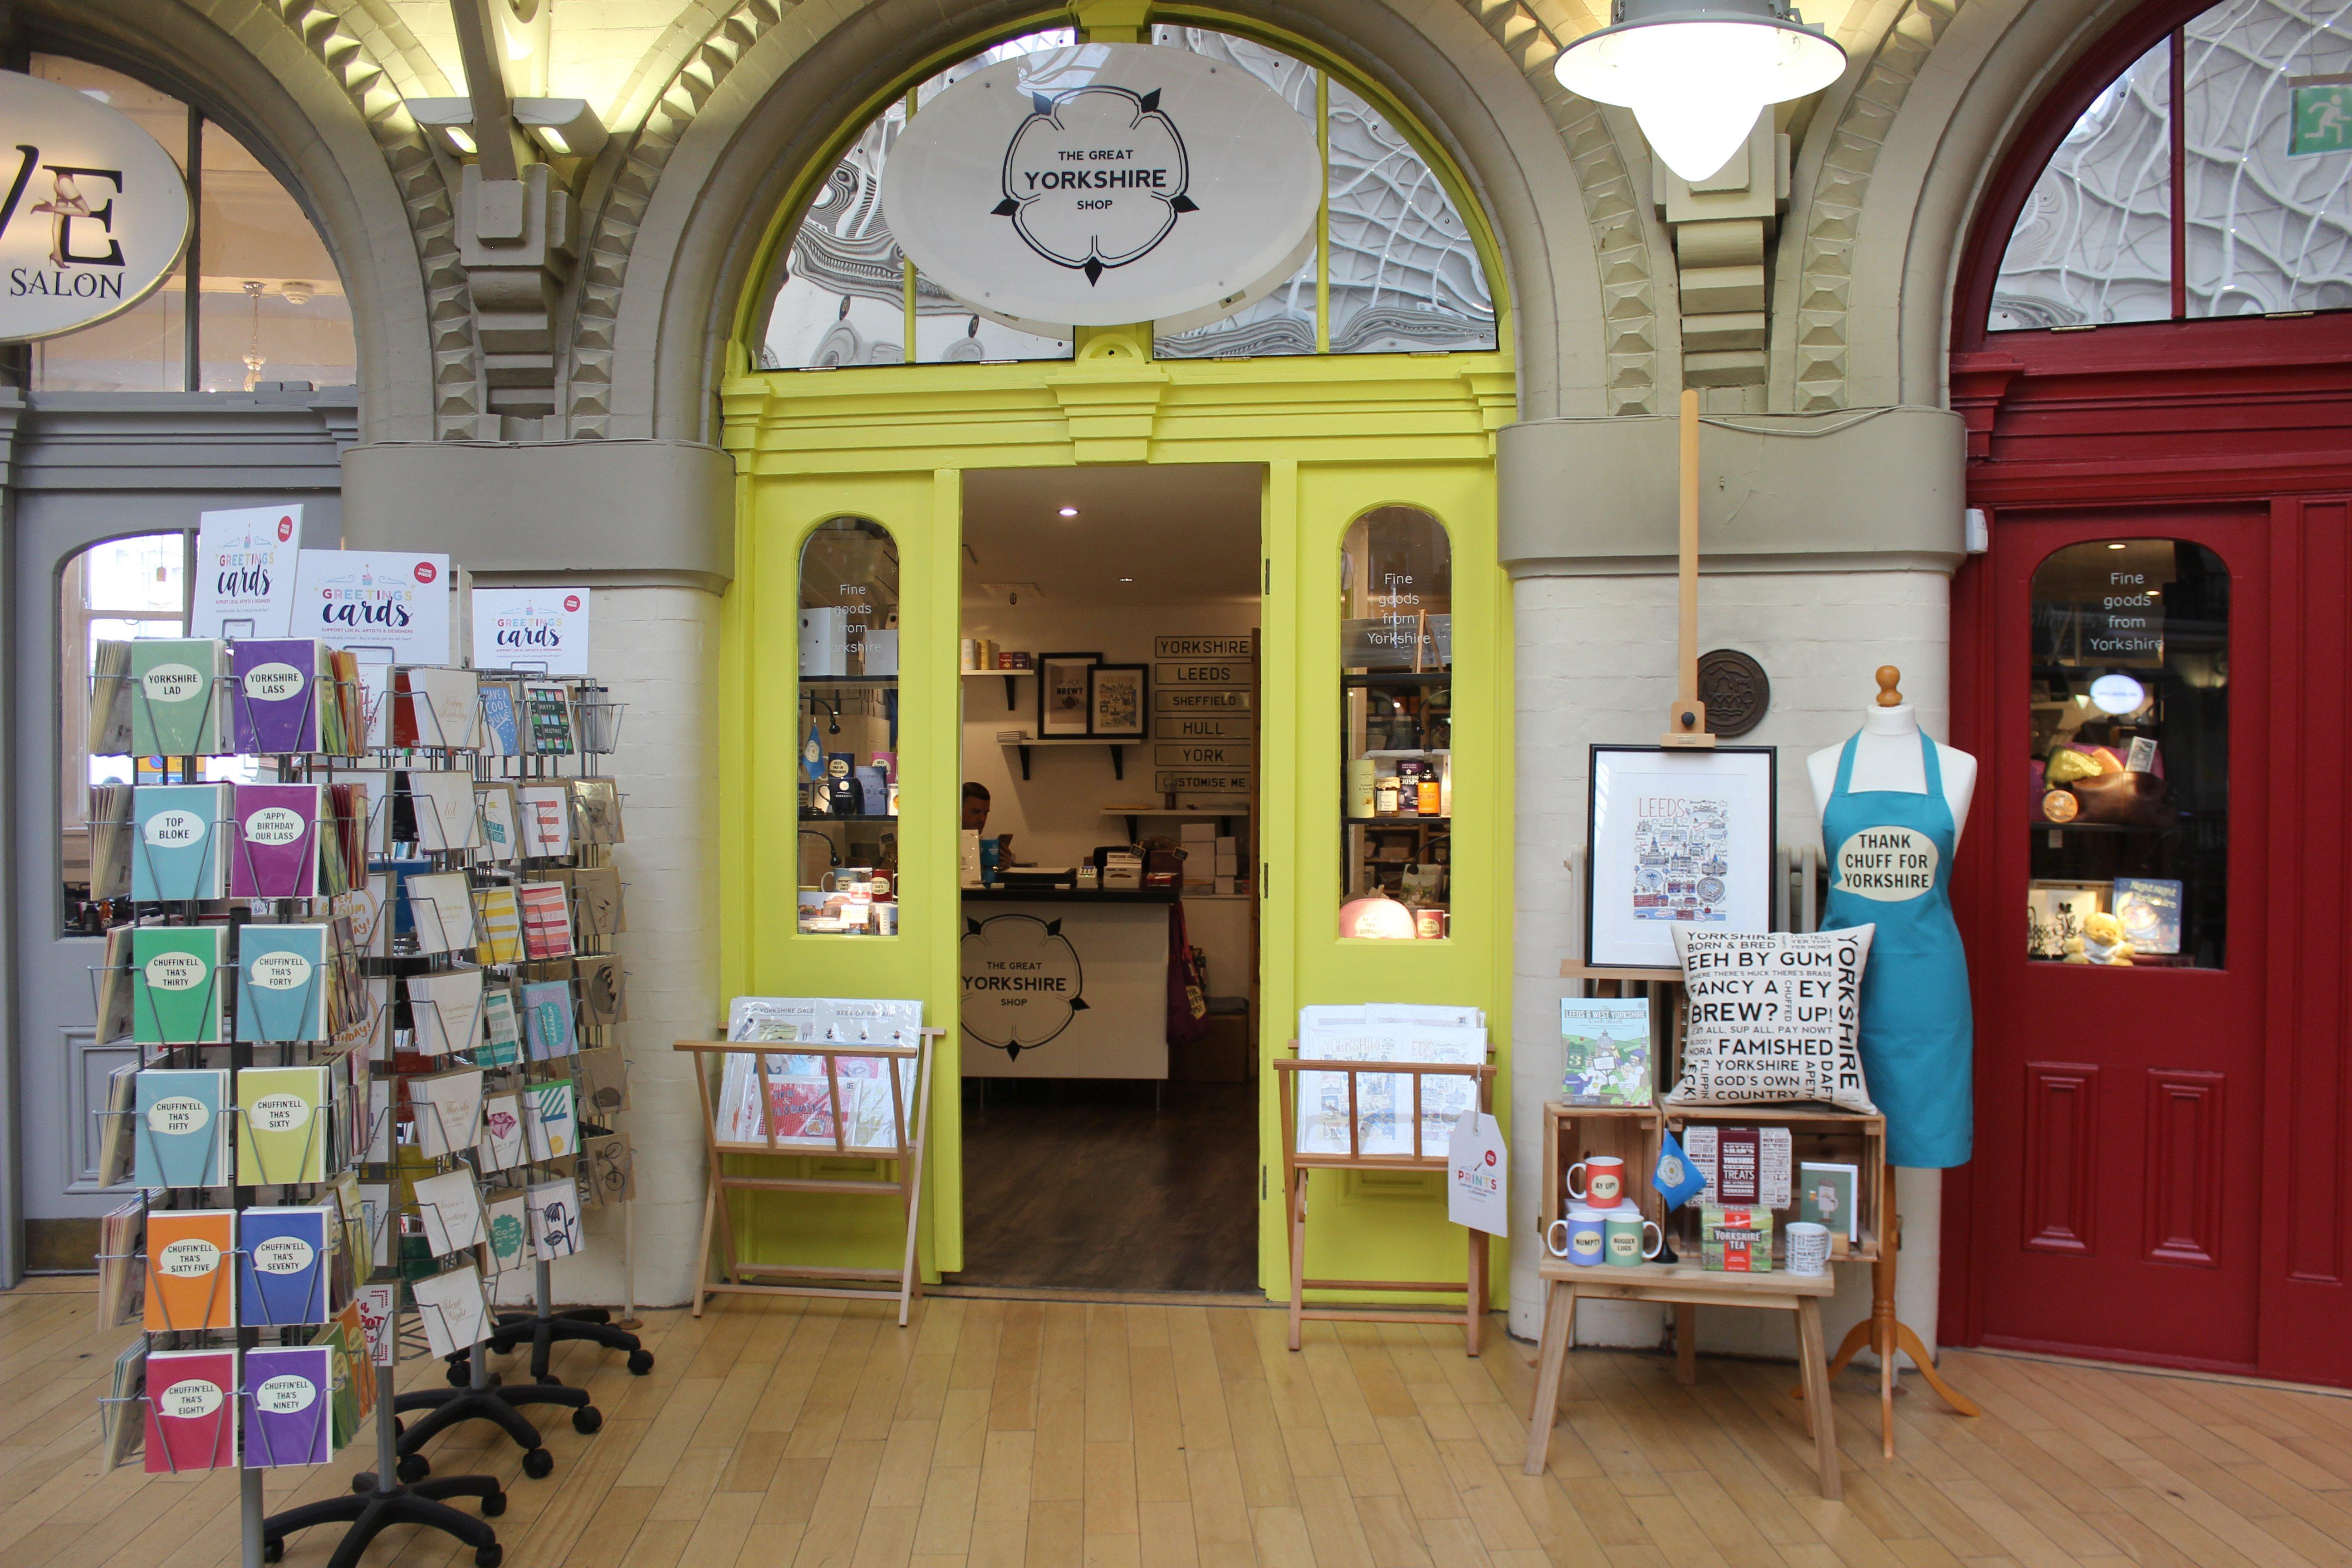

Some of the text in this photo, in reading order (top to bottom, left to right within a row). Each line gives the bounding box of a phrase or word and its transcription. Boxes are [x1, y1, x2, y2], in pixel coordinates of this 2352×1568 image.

[1058, 150, 1133, 161] THE GREAT
[1024, 169, 1166, 190] YORKSHIRE
[1077, 200, 1112, 210] SHOP
[10, 268, 125, 299] SALON
[220, 552, 274, 567] GREETINGS
[218, 560, 273, 597] cards
[1385, 573, 1413, 584] Fine
[2110, 573, 2144, 585] Fine
[323, 588, 412, 601] GREETINGS
[840, 584, 866, 595] Fine
[1378, 593, 1419, 607] goods
[2103, 594, 2151, 609] goods
[323, 596, 413, 627] cards
[834, 603, 872, 617] goods
[497, 618, 562, 627] GREETINGS
[1382, 613, 1415, 624] from
[2108, 616, 2146, 628] from
[838, 622, 867, 633] from
[497, 623, 563, 647] cards
[1367, 632, 1431, 644] Yorkshire
[825, 641, 882, 653] orkshire
[1160, 640, 1249, 653] YORKSHIRE
[2090, 638, 2164, 651] Yorkshire
[148, 674, 198, 684] YORKSHIRE
[250, 673, 299, 683] YORKSHIRE
[1178, 667, 1230, 680] LEEDS
[164, 686, 181, 695] LAD
[262, 684, 285, 694] LASS
[483, 690, 508, 701] HAVE A
[1173, 696, 1236, 706] SHEFFIELD
[486, 700, 509, 714] COOL
[1183, 722, 1225, 735] HULL
[1183, 749, 1224, 762] YORK
[1230, 778, 1246, 788] ME
[1639, 798, 1686, 818] LEEDS
[165, 818, 184, 827] TOP
[257, 822, 295, 830] BIRTHDAY
[159, 829, 190, 839] BLOKE
[274, 832, 294, 840] LASS
[1859, 834, 1911, 848] THANK
[1846, 854, 1928, 868] CHUFF FOR
[1845, 874, 1929, 888] YORKSHIRE
[1687, 932, 1776, 941] YORKSHIRE
[1688, 942, 1721, 953] BORN
[986, 962, 1042, 970] THE GREAT
[1688, 952, 1832, 971] EEH BY GUM
[166, 968, 186, 977] THA'S
[271, 968, 292, 976] THA'S
[163, 978, 189, 987] THIRTY
[270, 978, 292, 986] FORTY
[962, 977, 1066, 991] YORKSHIRE
[1690, 980, 1778, 997] FANCY A
[1800, 980, 1832, 998] EY
[1592, 1011, 1610, 1019] WEST
[1611, 1010, 1646, 1019] YORKSHIRE
[1692, 1003, 1778, 1024] BREW?
[1798, 1007, 1833, 1023] UP!
[1838, 935, 1859, 1090] YORKSHIRE
[1690, 1048, 1713, 1056] NORA
[1720, 1039, 1833, 1056] FAMISHED
[1569, 1055, 1582, 1066] 3
[1716, 1060, 1799, 1071] YORKSHIRE
[1715, 1076, 1799, 1086] GOD'S OWN
[1806, 1061, 1815, 1100] APETH
[1821, 1061, 1833, 1102] DAFT
[1716, 1091, 1799, 1100] COUNTRY
[169, 1112, 189, 1120] THA'S
[270, 1110, 290, 1119] THA'S
[168, 1122, 188, 1131] FIFTY
[269, 1120, 290, 1128] SIXTY
[1459, 1170, 1496, 1191] PRINTS
[1724, 1170, 1754, 1180] TREATS
[495, 1226, 503, 1249] LUCK
[501, 1230, 508, 1239] OF
[509, 1222, 517, 1245] BEST
[1715, 1230, 1760, 1241] YORKSHIRE
[1730, 1242, 1745, 1250] TEA
[180, 1254, 201, 1263] THA'S
[171, 1264, 210, 1273] SIXTY FIVE
[267, 1262, 299, 1270] SEVENTY
[182, 1396, 202, 1404] THA'S
[277, 1391, 297, 1399] THA'S
[178, 1405, 205, 1414] EIGHTY
[274, 1401, 299, 1409] NINETY
